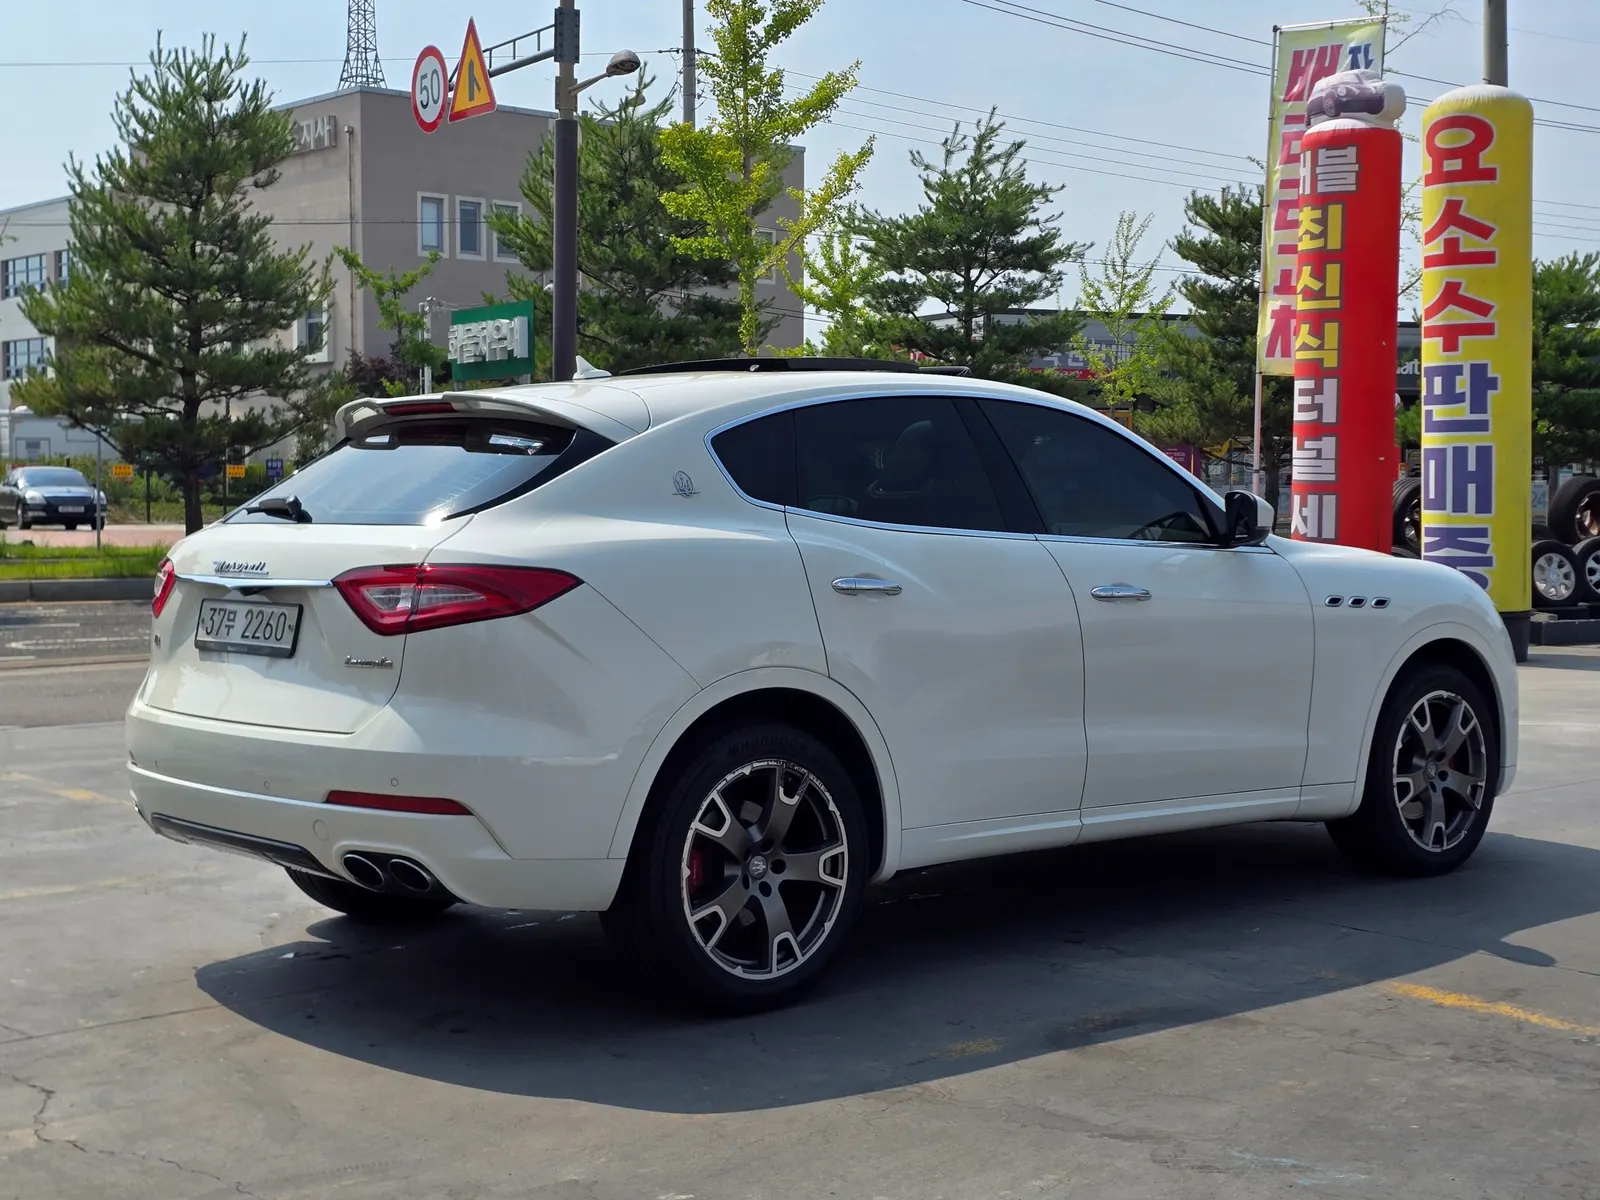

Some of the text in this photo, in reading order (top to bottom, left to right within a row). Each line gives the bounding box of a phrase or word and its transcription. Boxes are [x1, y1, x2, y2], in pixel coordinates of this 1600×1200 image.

[420, 68, 441, 109] 50
[294, 115, 333, 150] 지사
[1295, 204, 1343, 368] 최신식
[1396, 359, 1420, 374] art
[205, 607, 288, 642] 37무 2260
